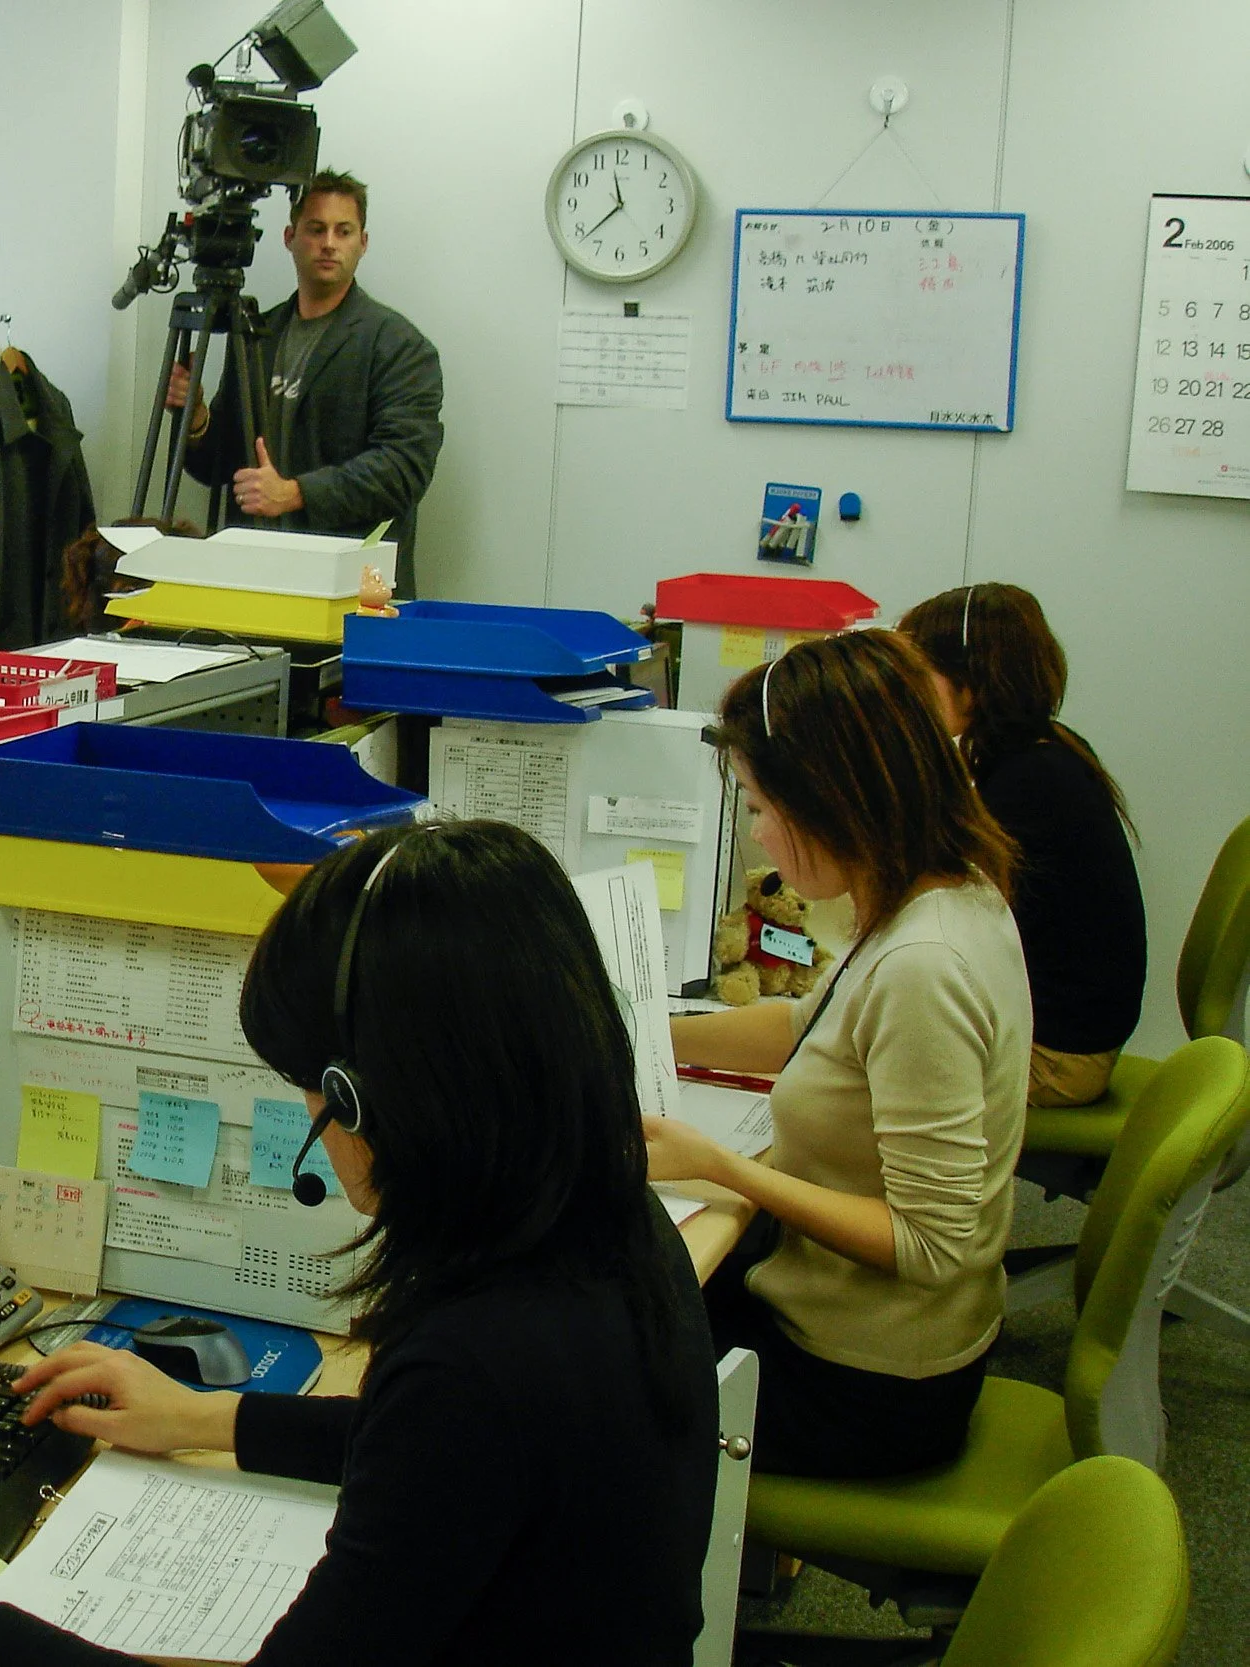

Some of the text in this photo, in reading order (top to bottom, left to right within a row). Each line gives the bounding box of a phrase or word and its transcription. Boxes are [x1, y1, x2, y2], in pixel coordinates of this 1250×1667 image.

[594, 154, 604, 170] 11
[615, 149, 629, 165] 12
[573, 172, 589, 188] 10
[659, 172, 667, 188] 2
[567, 197, 577, 213] 9
[575, 222, 585, 237] 8
[654, 224, 664, 239] 4
[1162, 217, 1235, 251] 2 Feb 2006
[593, 240, 603, 256] 7
[615, 247, 624, 261] 6
[638, 241, 648, 257] 5
[1242, 265, 1249, 281] 1
[1158, 300, 1250, 320] 5 6 7 8
[1156, 339, 1250, 360] 12 13 14 15
[1152, 377, 1168, 394] 19
[1178, 379, 1201, 397] 20
[1205, 381, 1224, 397] 21
[816, 393, 851, 407] PAUL
[1148, 416, 1224, 437] 26 27 28
